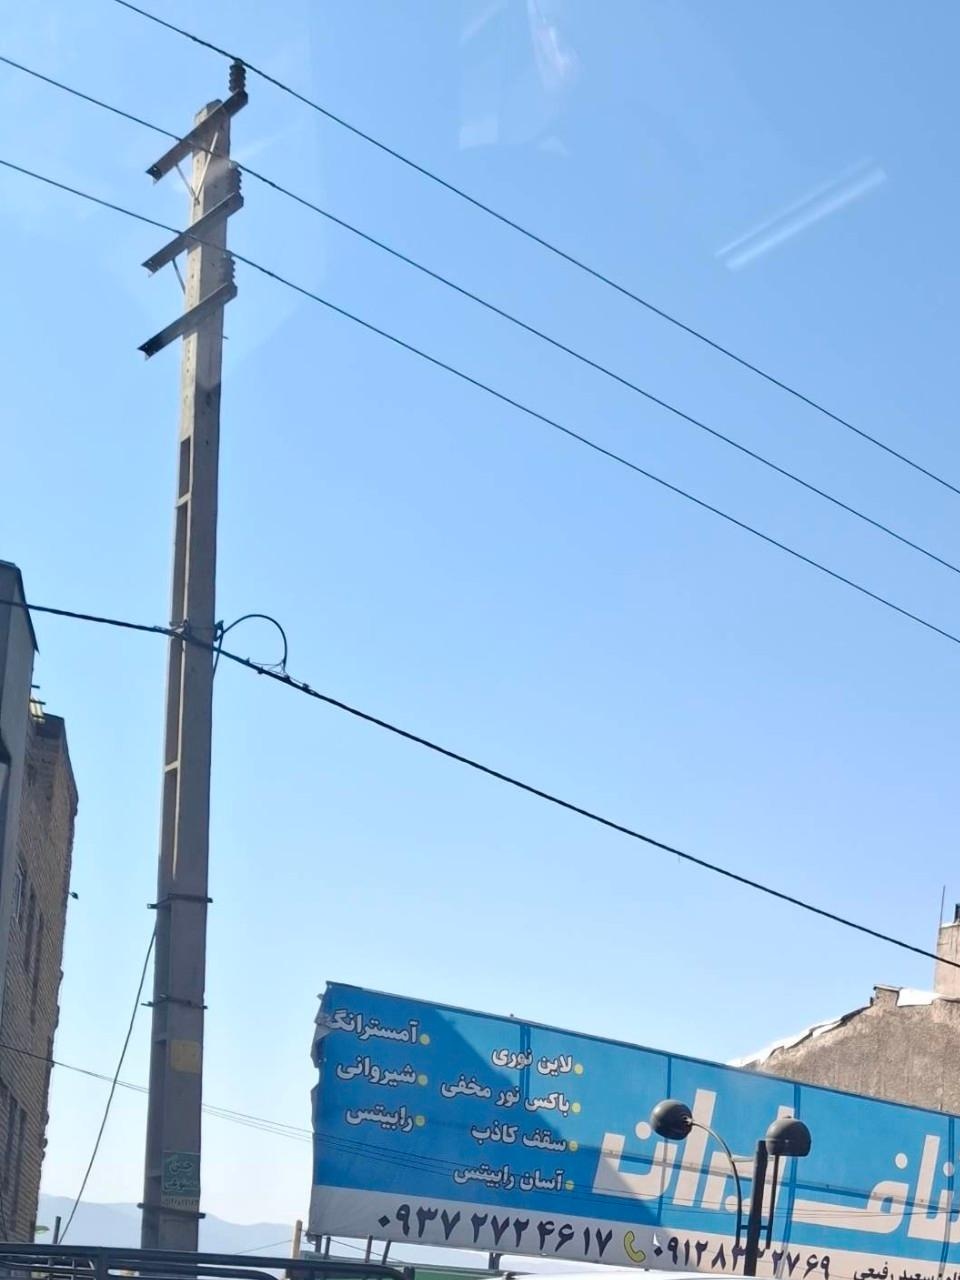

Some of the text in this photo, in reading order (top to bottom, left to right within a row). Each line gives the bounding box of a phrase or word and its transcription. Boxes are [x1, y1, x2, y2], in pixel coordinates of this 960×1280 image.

[326, 1009, 418, 1043] آمسترانگ
[337, 1056, 416, 1087] شیروانی
[492, 1048, 573, 1076] لاین نوری
[441, 1074, 570, 1117] باکس نور مخفی
[346, 1104, 414, 1132] رابیتس
[471, 1120, 567, 1151] سقف کاذب
[592, 1088, 795, 1218] ایران
[454, 1164, 564, 1191] آسان رابیتس
